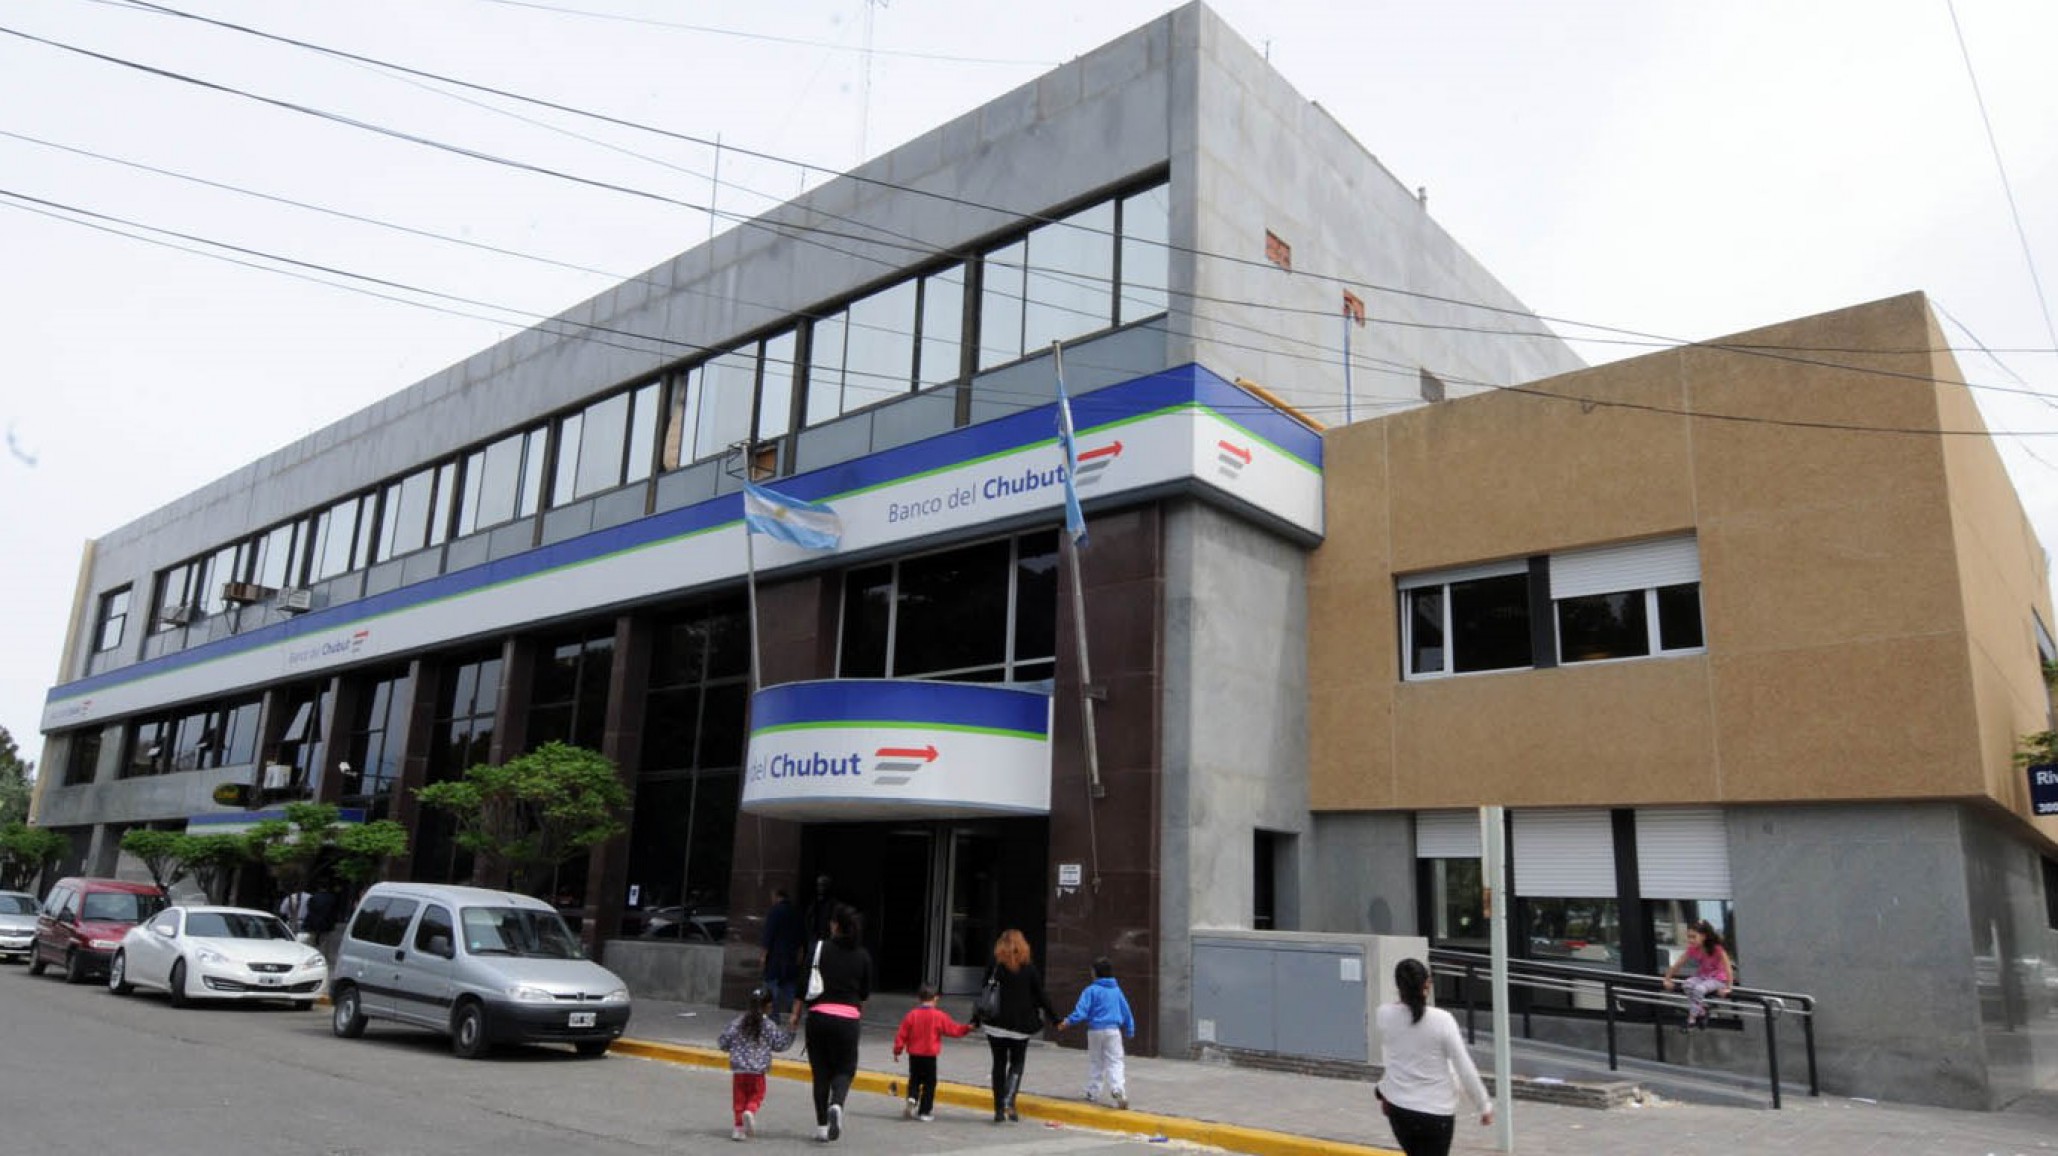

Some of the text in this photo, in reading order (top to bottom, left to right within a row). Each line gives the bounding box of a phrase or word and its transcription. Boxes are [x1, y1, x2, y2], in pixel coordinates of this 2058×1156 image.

[888, 464, 1067, 523] Banco del Chubut
[770, 751, 861, 778] Chubut
